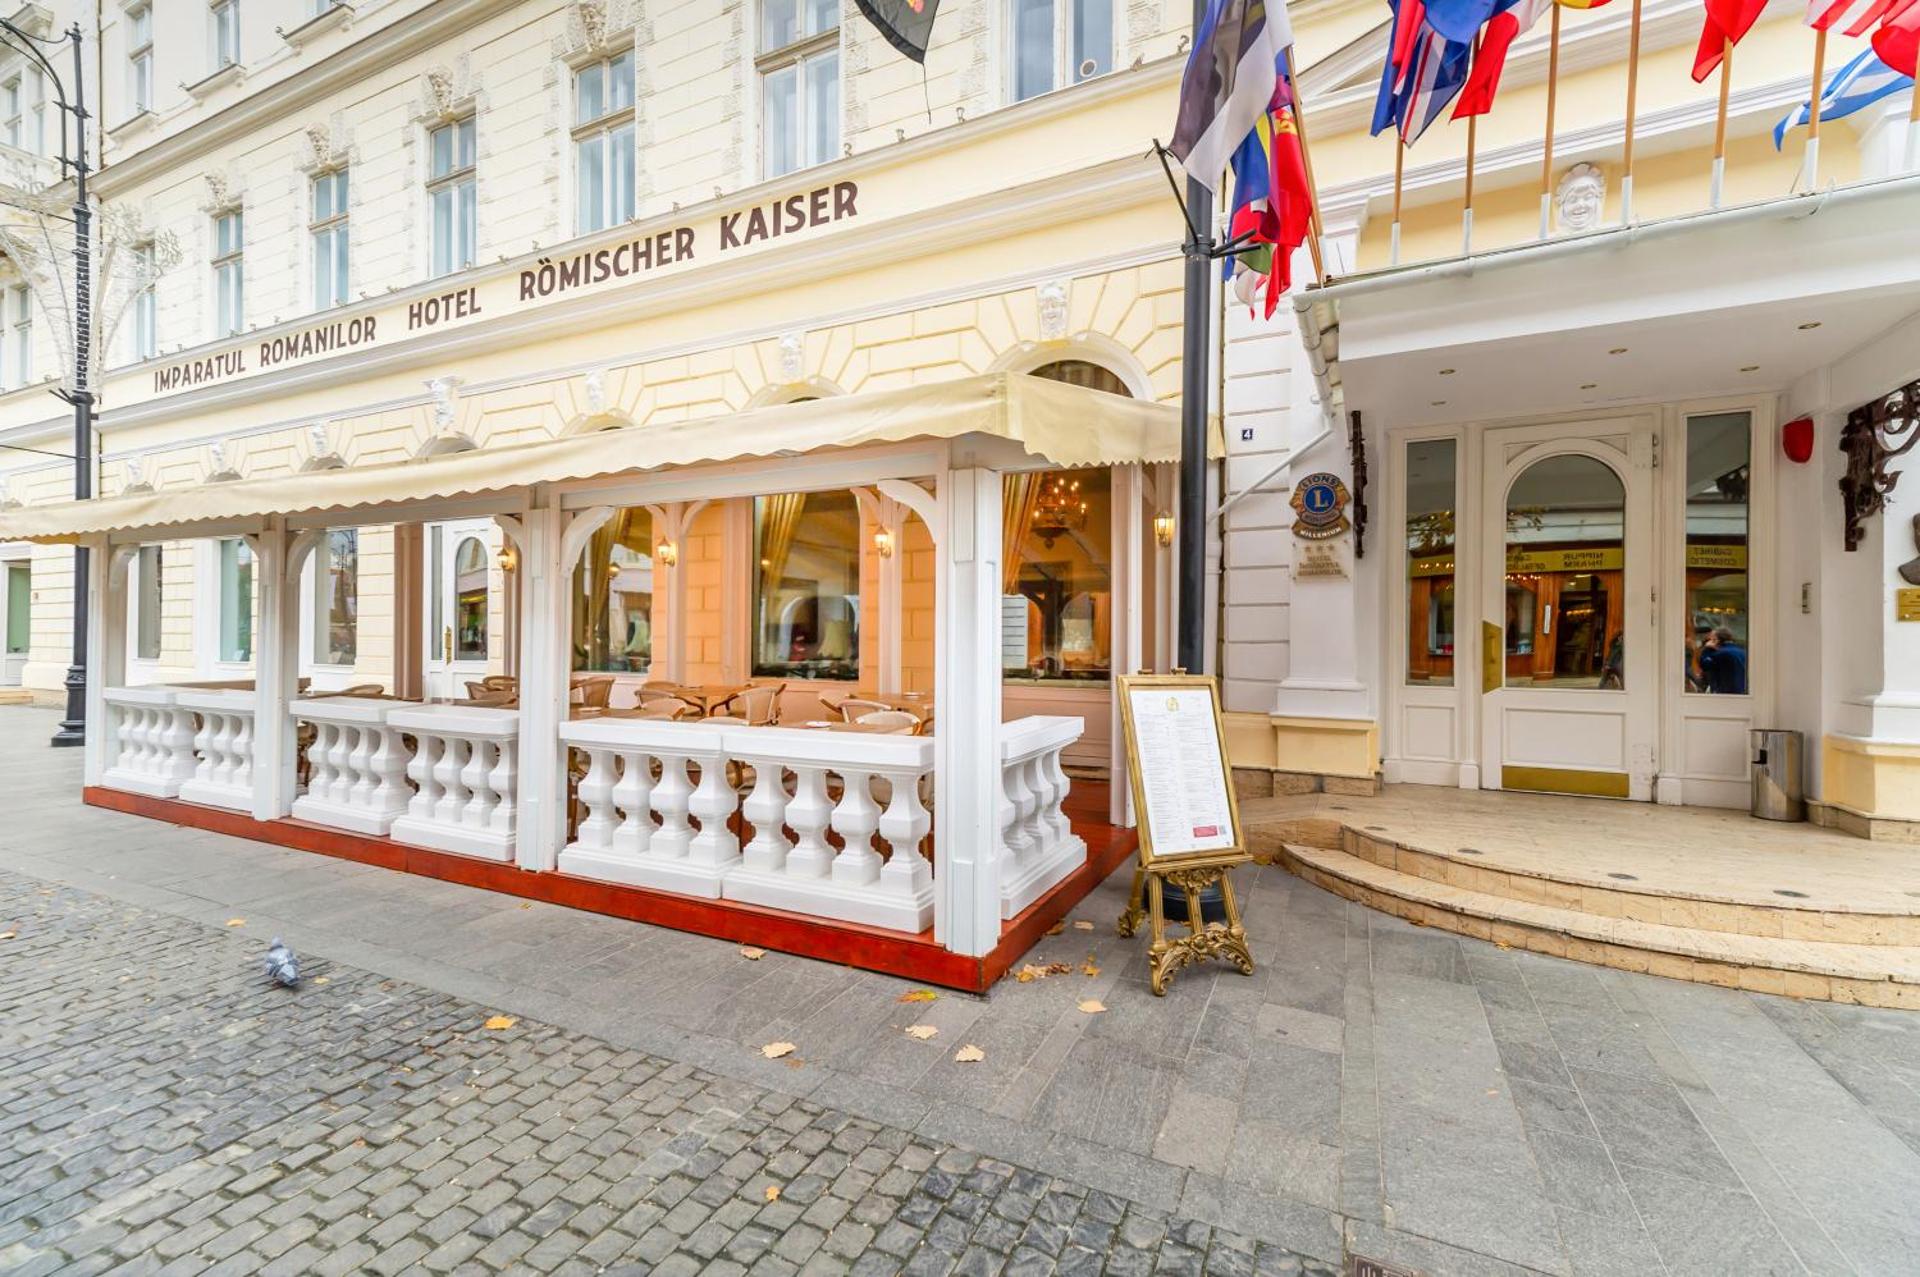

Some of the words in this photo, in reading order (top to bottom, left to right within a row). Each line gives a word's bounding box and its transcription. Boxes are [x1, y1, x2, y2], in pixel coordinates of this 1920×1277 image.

[154, 350, 246, 393] IMPARATUL
[260, 317, 376, 368] ROMANILOR
[409, 287, 481, 329] HOTEL
[521, 228, 694, 301] RÖMISCHER
[721, 182, 857, 250] KAISER
[1243, 429, 1251, 439] 4
[1302, 475, 1337, 487] LIONS
[1313, 489, 1328, 508] L
